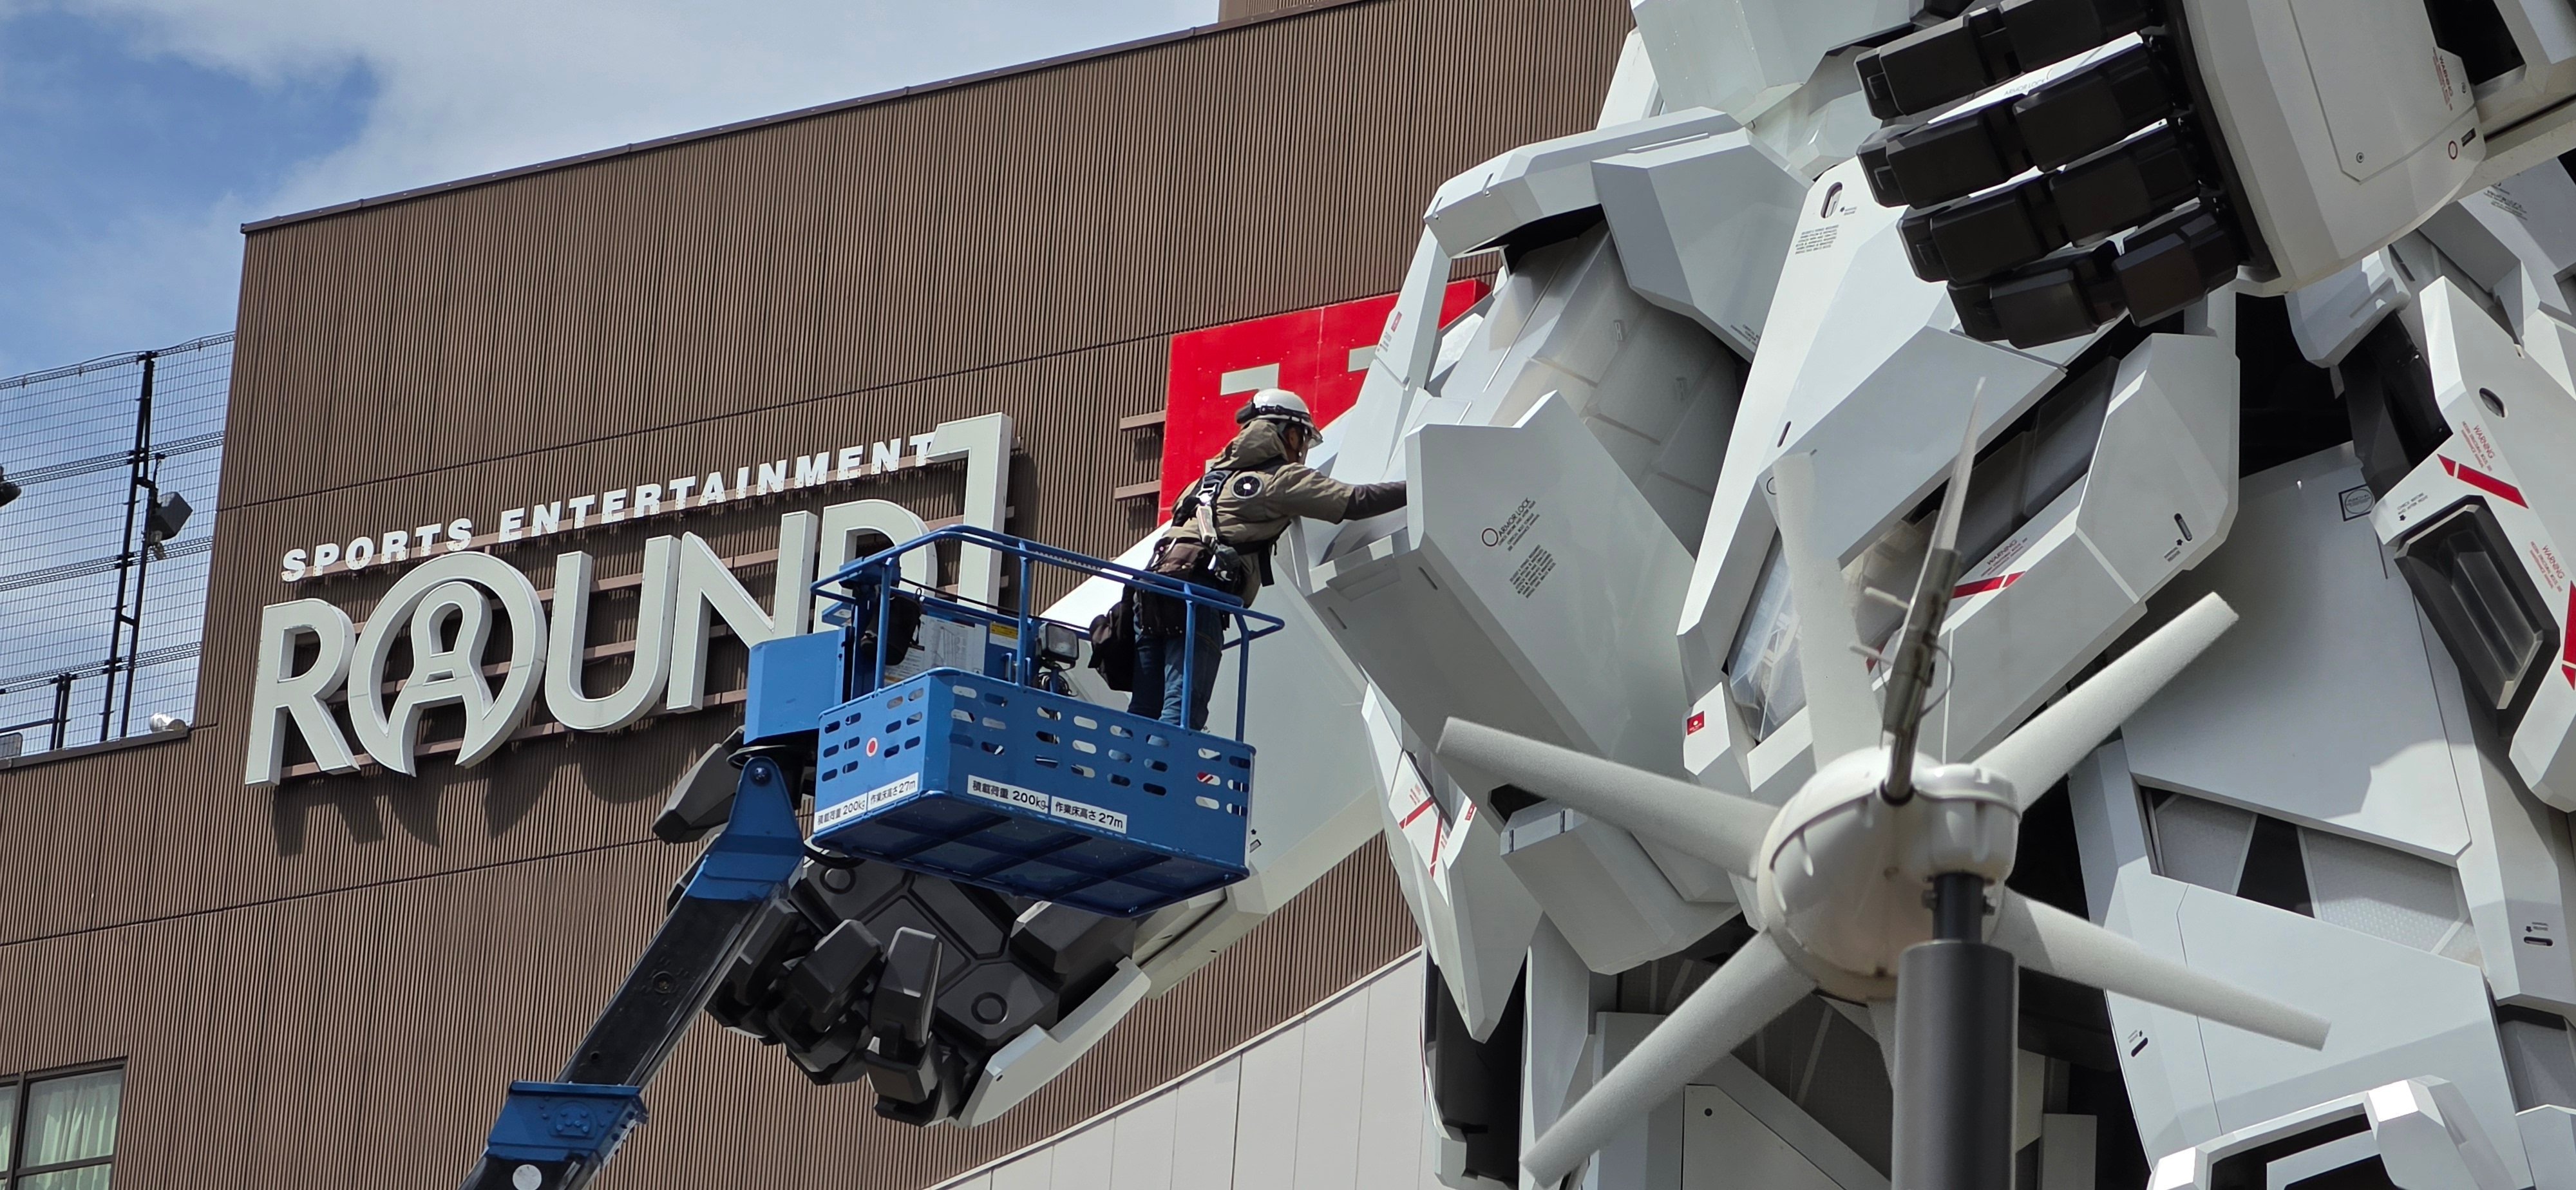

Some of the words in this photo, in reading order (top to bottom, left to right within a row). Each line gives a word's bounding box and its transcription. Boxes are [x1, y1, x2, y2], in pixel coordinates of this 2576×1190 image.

[2474, 424, 2495, 458] WARNING
[281, 518, 473, 582] SPORTS
[498, 431, 935, 543] ENTERTAINMENT
[1499, 513, 1517, 537] ARMOR
[1515, 496, 1531, 516] LOCK
[1987, 539, 2017, 565] WARNING
[2543, 545, 2565, 579] WARNING
[898, 780, 916, 794] 27m
[972, 780, 1009, 800] 積載荷重
[1012, 790, 1048, 810] 200kg
[1055, 802, 1097, 821] 作業床高さ
[1098, 812, 1124, 829] 27m
